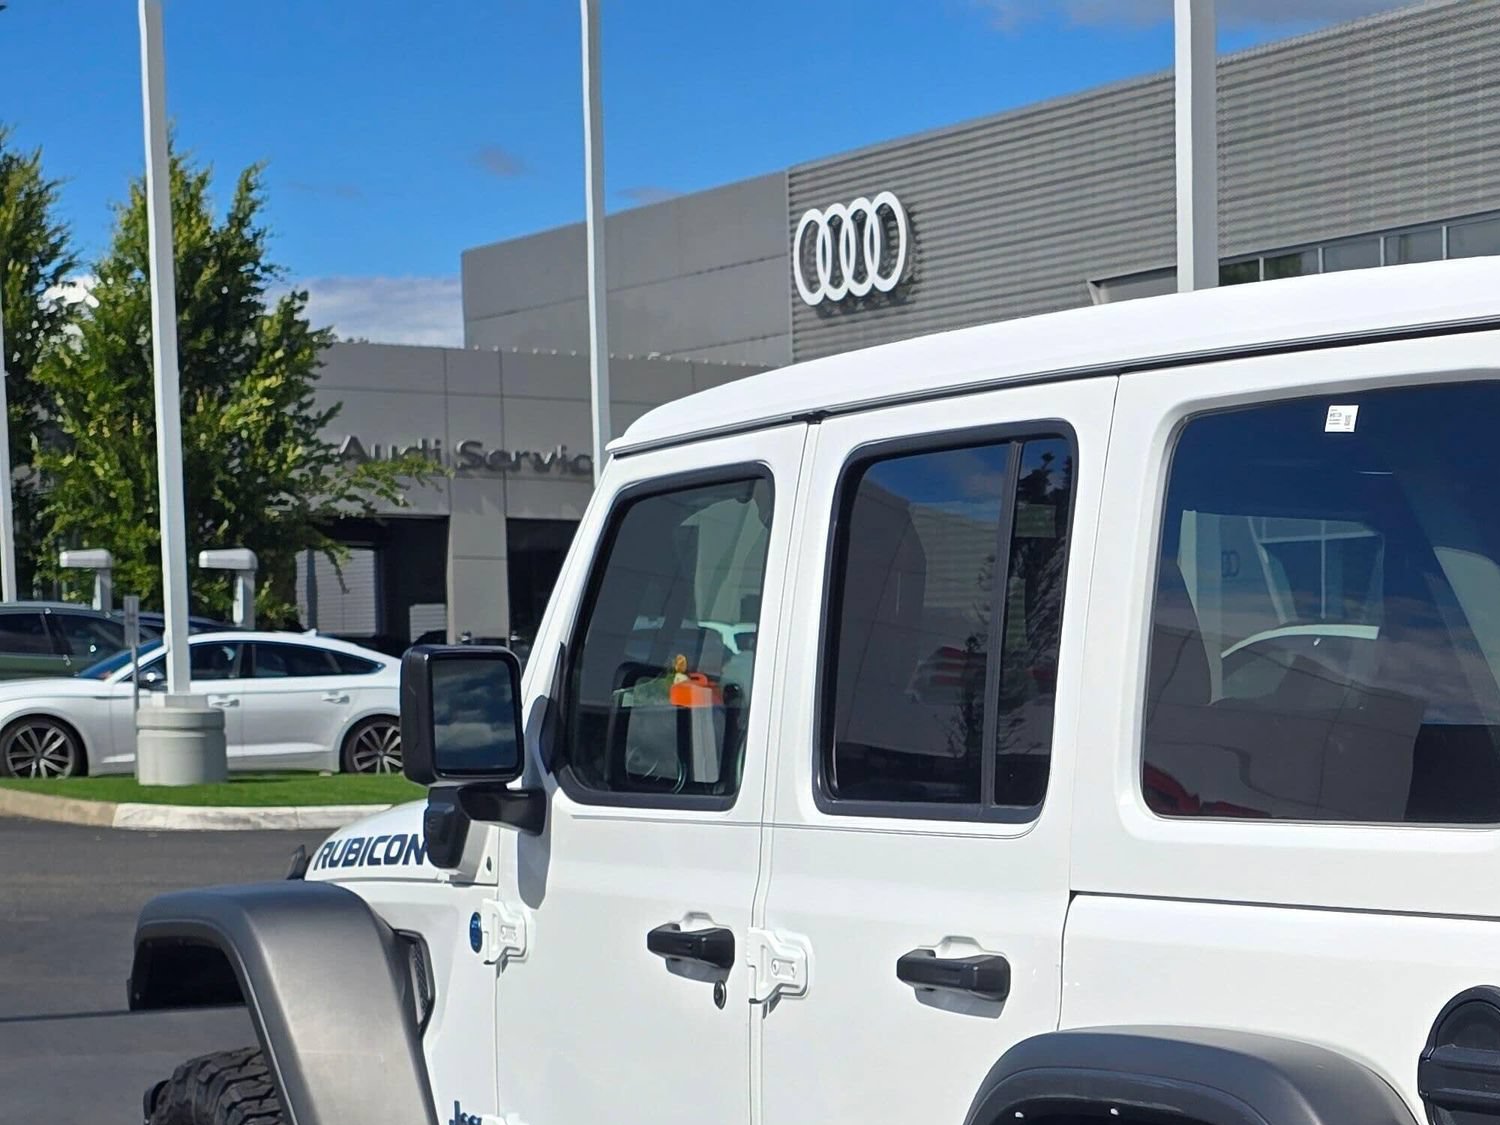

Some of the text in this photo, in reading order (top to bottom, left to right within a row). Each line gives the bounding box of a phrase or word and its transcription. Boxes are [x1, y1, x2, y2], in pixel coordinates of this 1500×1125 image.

[339, 435, 594, 474] Audi Servic
[313, 833, 428, 871] RUBICON
